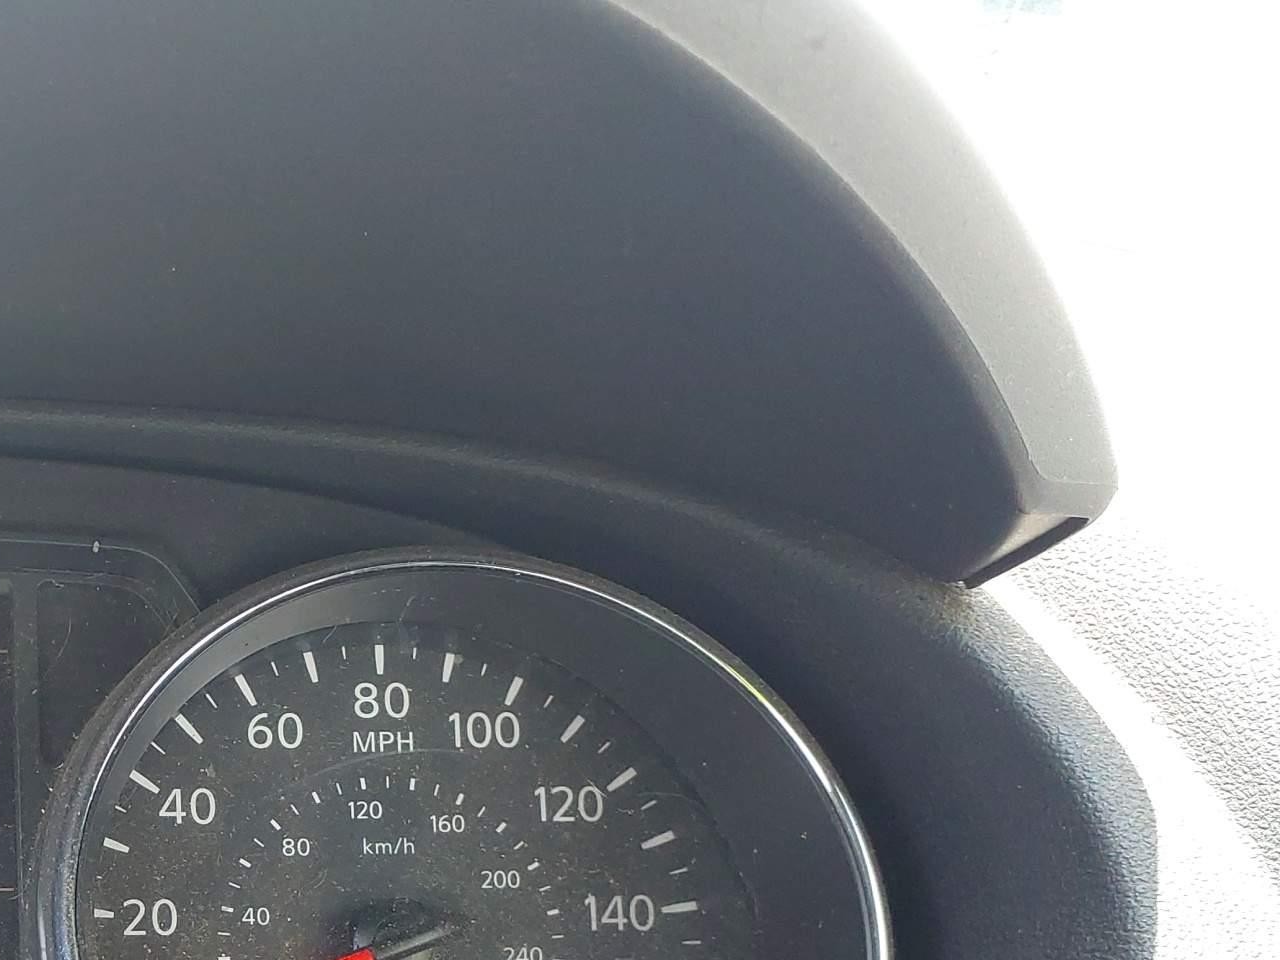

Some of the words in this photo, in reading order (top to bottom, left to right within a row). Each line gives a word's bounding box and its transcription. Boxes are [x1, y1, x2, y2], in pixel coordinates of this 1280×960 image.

[353, 682, 410, 719] 80
[247, 712, 303, 749] 60
[353, 731, 415, 752] MPH
[448, 711, 520, 748] 100
[158, 788, 216, 825] 40
[348, 801, 383, 820] 120
[534, 785, 603, 822] 120
[430, 814, 465, 833] 160
[282, 838, 311, 856] 80
[362, 837, 416, 855] km/h
[480, 870, 520, 889] 200
[122, 899, 178, 936] 20
[241, 907, 270, 925] 40
[584, 894, 655, 931] 140
